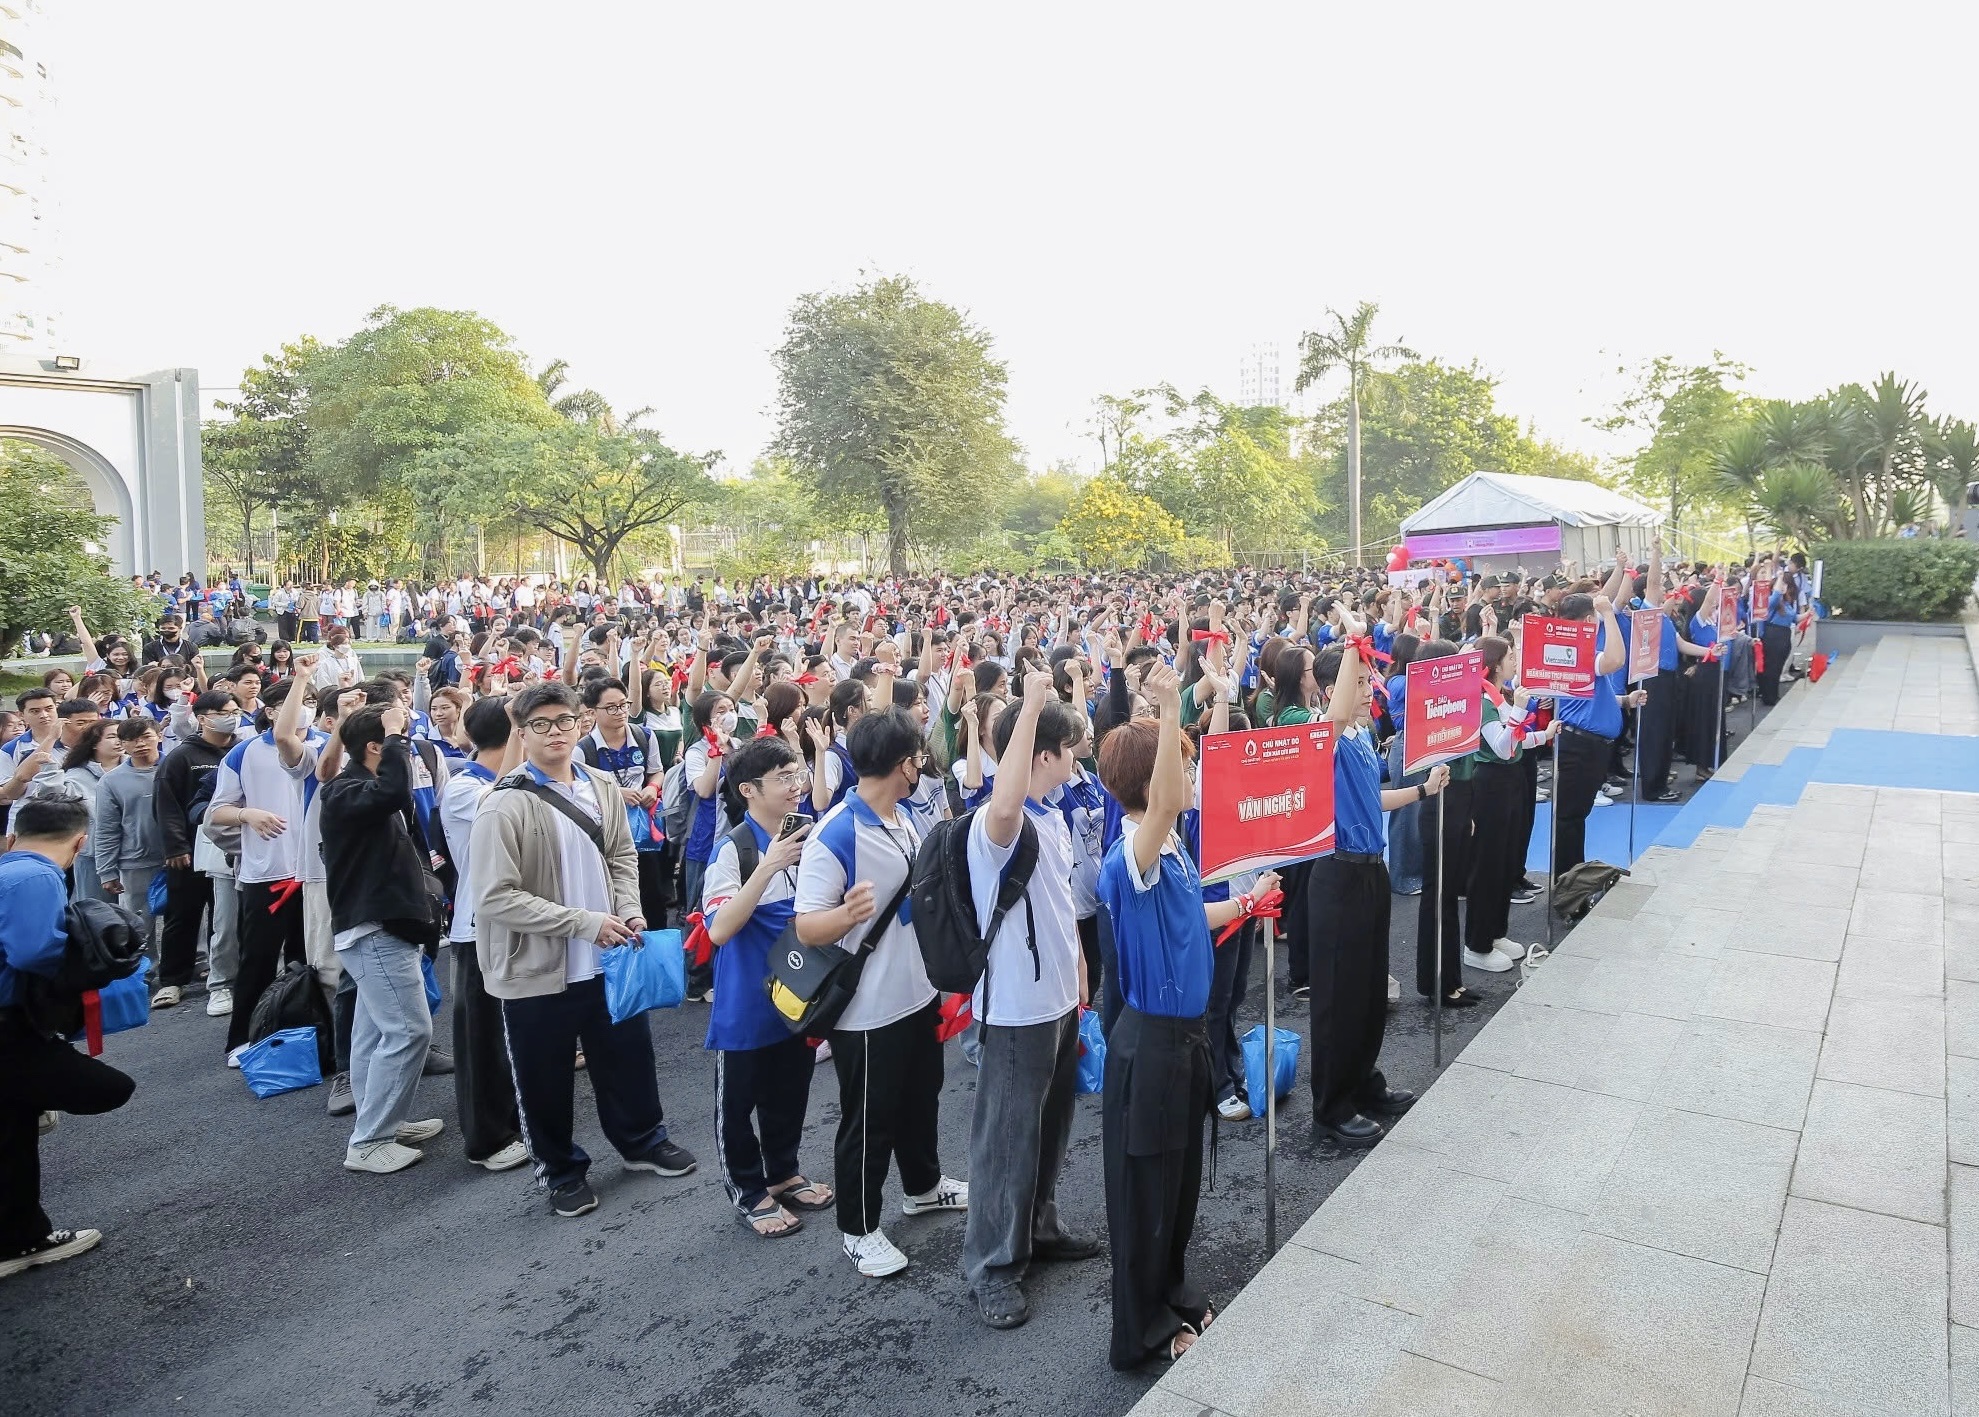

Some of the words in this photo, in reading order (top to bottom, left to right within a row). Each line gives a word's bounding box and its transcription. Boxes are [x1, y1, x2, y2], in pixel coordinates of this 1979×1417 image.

[1262, 739, 1274, 749] CHỦ
[1274, 738, 1290, 748] NHẬT
[1291, 736, 1299, 745] ĐỎ
[1238, 795, 1262, 822] VĂN
[1263, 789, 1293, 818] NGHỆ
[1293, 786, 1306, 811] SĨ
